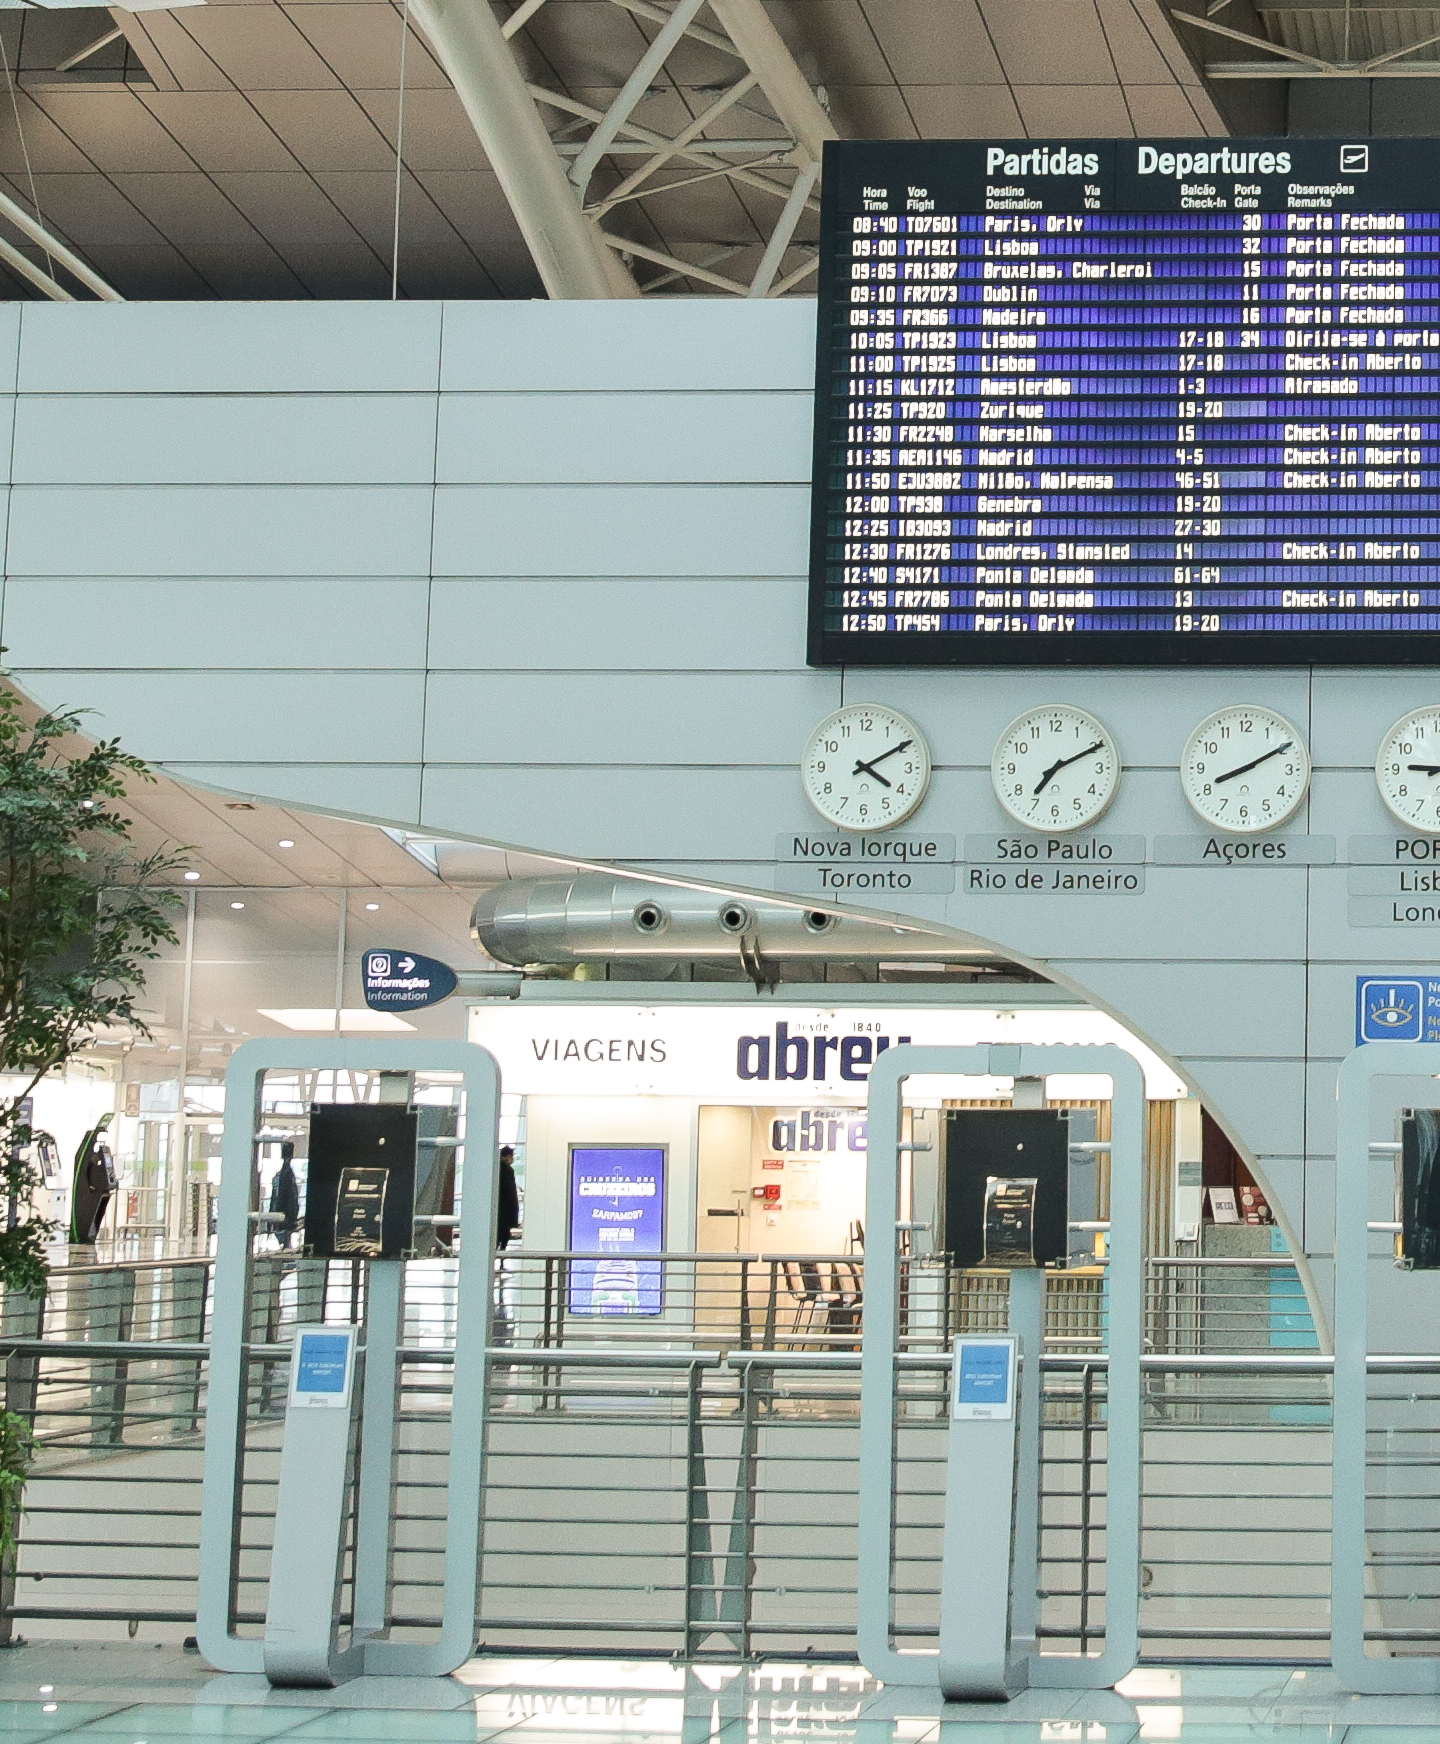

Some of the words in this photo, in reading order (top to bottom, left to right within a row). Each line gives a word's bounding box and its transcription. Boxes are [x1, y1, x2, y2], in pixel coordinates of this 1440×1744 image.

[986, 146, 1099, 176] Partidas
[1137, 146, 1292, 180] Departures
[863, 186, 887, 198] Hora
[907, 186, 927, 197] Voo
[986, 186, 1025, 197] Destino
[1084, 185, 1101, 196] Via
[1234, 184, 1261, 195] Porta
[863, 199, 888, 211] Time
[906, 199, 935, 212] Flight
[985, 199, 1043, 210] Destination
[1084, 198, 1101, 209] Via
[1180, 197, 1227, 208] Check-In
[1234, 197, 1259, 208] Gate
[1287, 197, 1332, 208] Remarks
[1242, 214, 1262, 231] 30
[1287, 213, 1333, 231] Porta
[1341, 213, 1405, 231] Fechada
[852, 239, 897, 257] 09:00
[984, 239, 1039, 256] Lisboa
[850, 285, 896, 303] 09:10
[983, 285, 1038, 302] Dublin
[850, 309, 895, 326] 09:35
[1240, 330, 1260, 348] 34
[850, 355, 894, 373] 11:00
[1285, 353, 1359, 371] Check-in
[1366, 353, 1422, 370] Aberto
[849, 379, 893, 396] 11:15
[848, 402, 892, 420] 11:25
[846, 449, 891, 466] 11:35
[978, 448, 1034, 466] Madrid
[845, 519, 889, 537] 12:25
[844, 543, 889, 561] 12:30
[842, 590, 887, 608] 12:45
[842, 614, 887, 632] 12:50
[792, 837, 852, 858] Nova
[861, 837, 937, 863] Iorque
[997, 838, 1039, 860] São
[1047, 839, 1113, 860] Paulo
[1202, 837, 1287, 865] Açores
[818, 868, 912, 889] Toronto
[970, 868, 1007, 889] Rio
[1015, 868, 1044, 889] de
[1051, 869, 1138, 890] Janeiro
[367, 977, 430, 990] Informações
[367, 990, 428, 1001] Information
[852, 1022, 882, 1034] 1840
[530, 1037, 667, 1063] VIAGENS
[736, 1021, 912, 1081] abre
